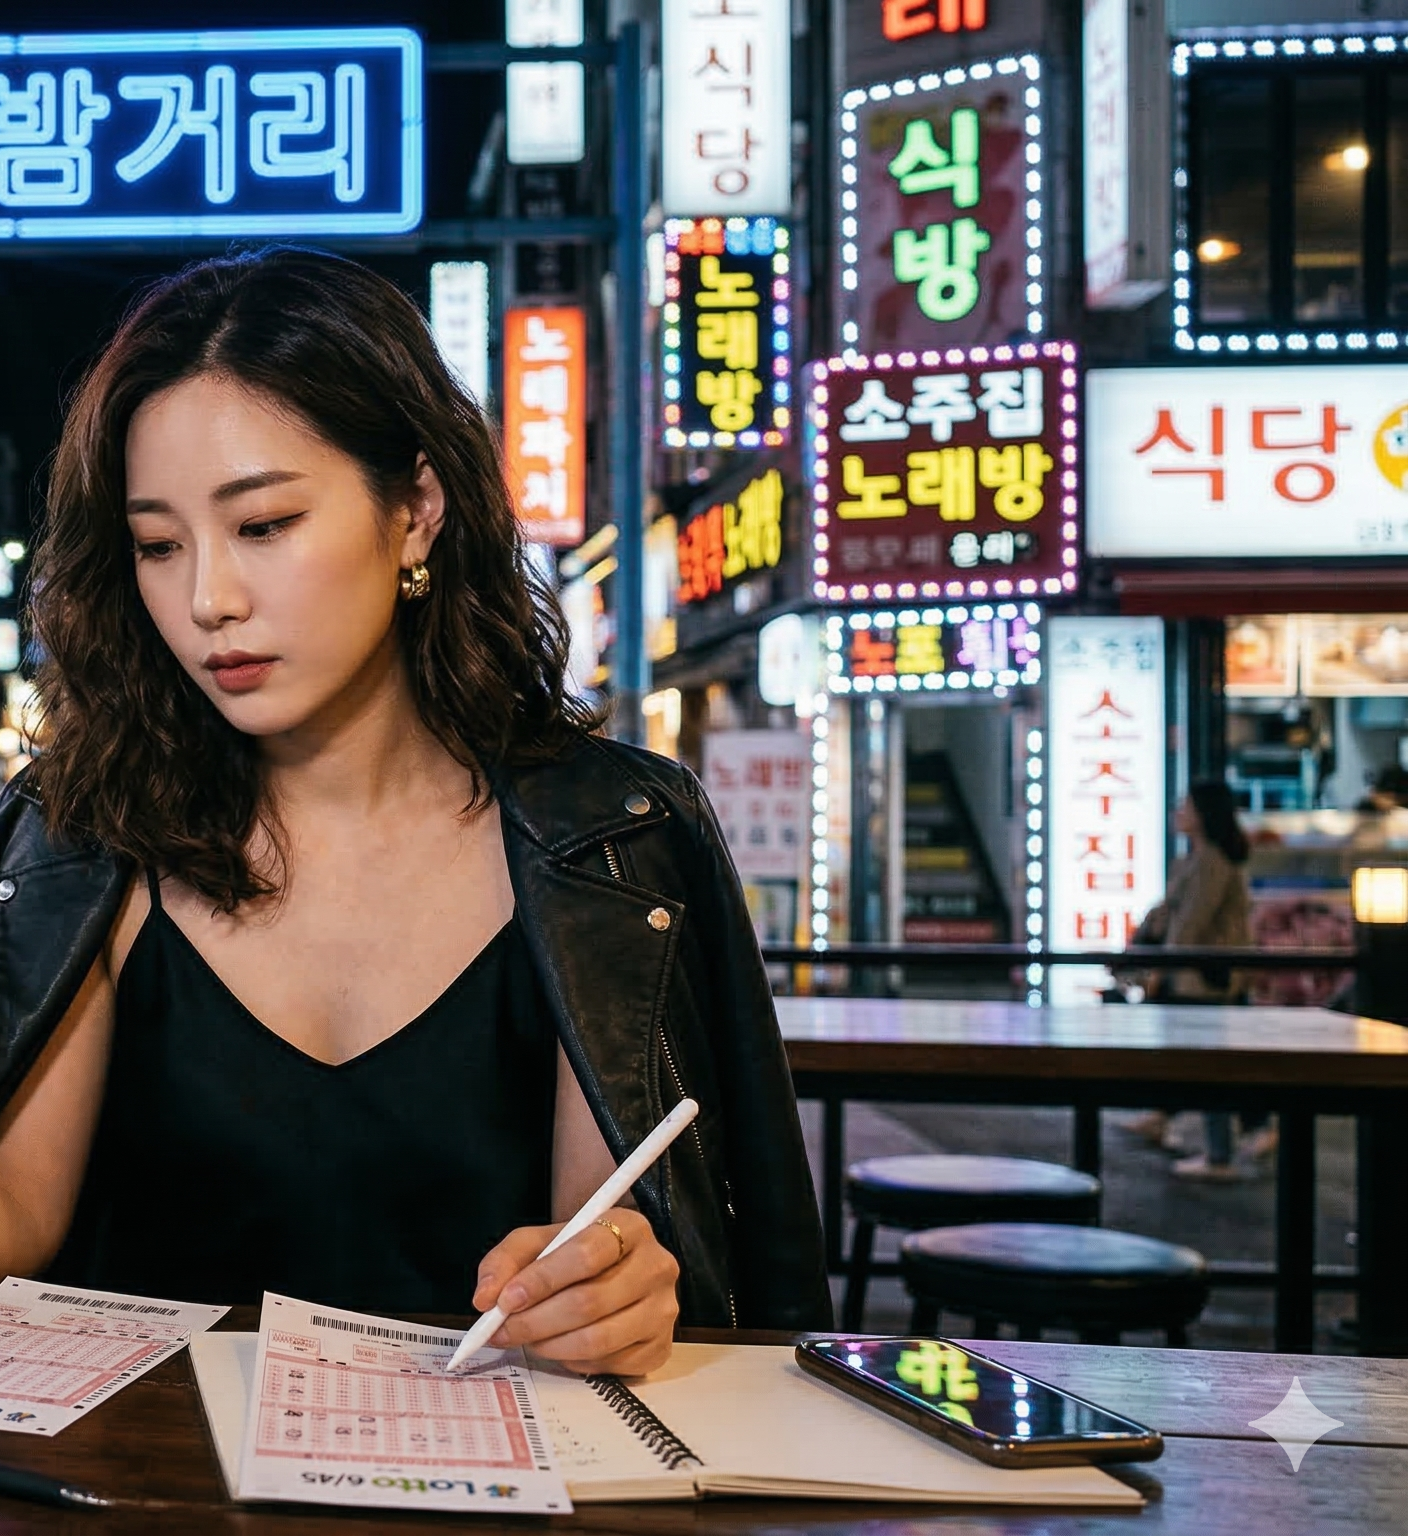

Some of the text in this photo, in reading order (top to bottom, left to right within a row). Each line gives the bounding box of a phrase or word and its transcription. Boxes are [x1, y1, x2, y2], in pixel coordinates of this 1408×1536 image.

[889, 107, 991, 322] 식방
[839, 366, 1045, 443] 소주집
[836, 443, 1054, 522] 노래방
[1134, 403, 1353, 504] 식당
[300, 1471, 476, 1496] Lotto 6/45
